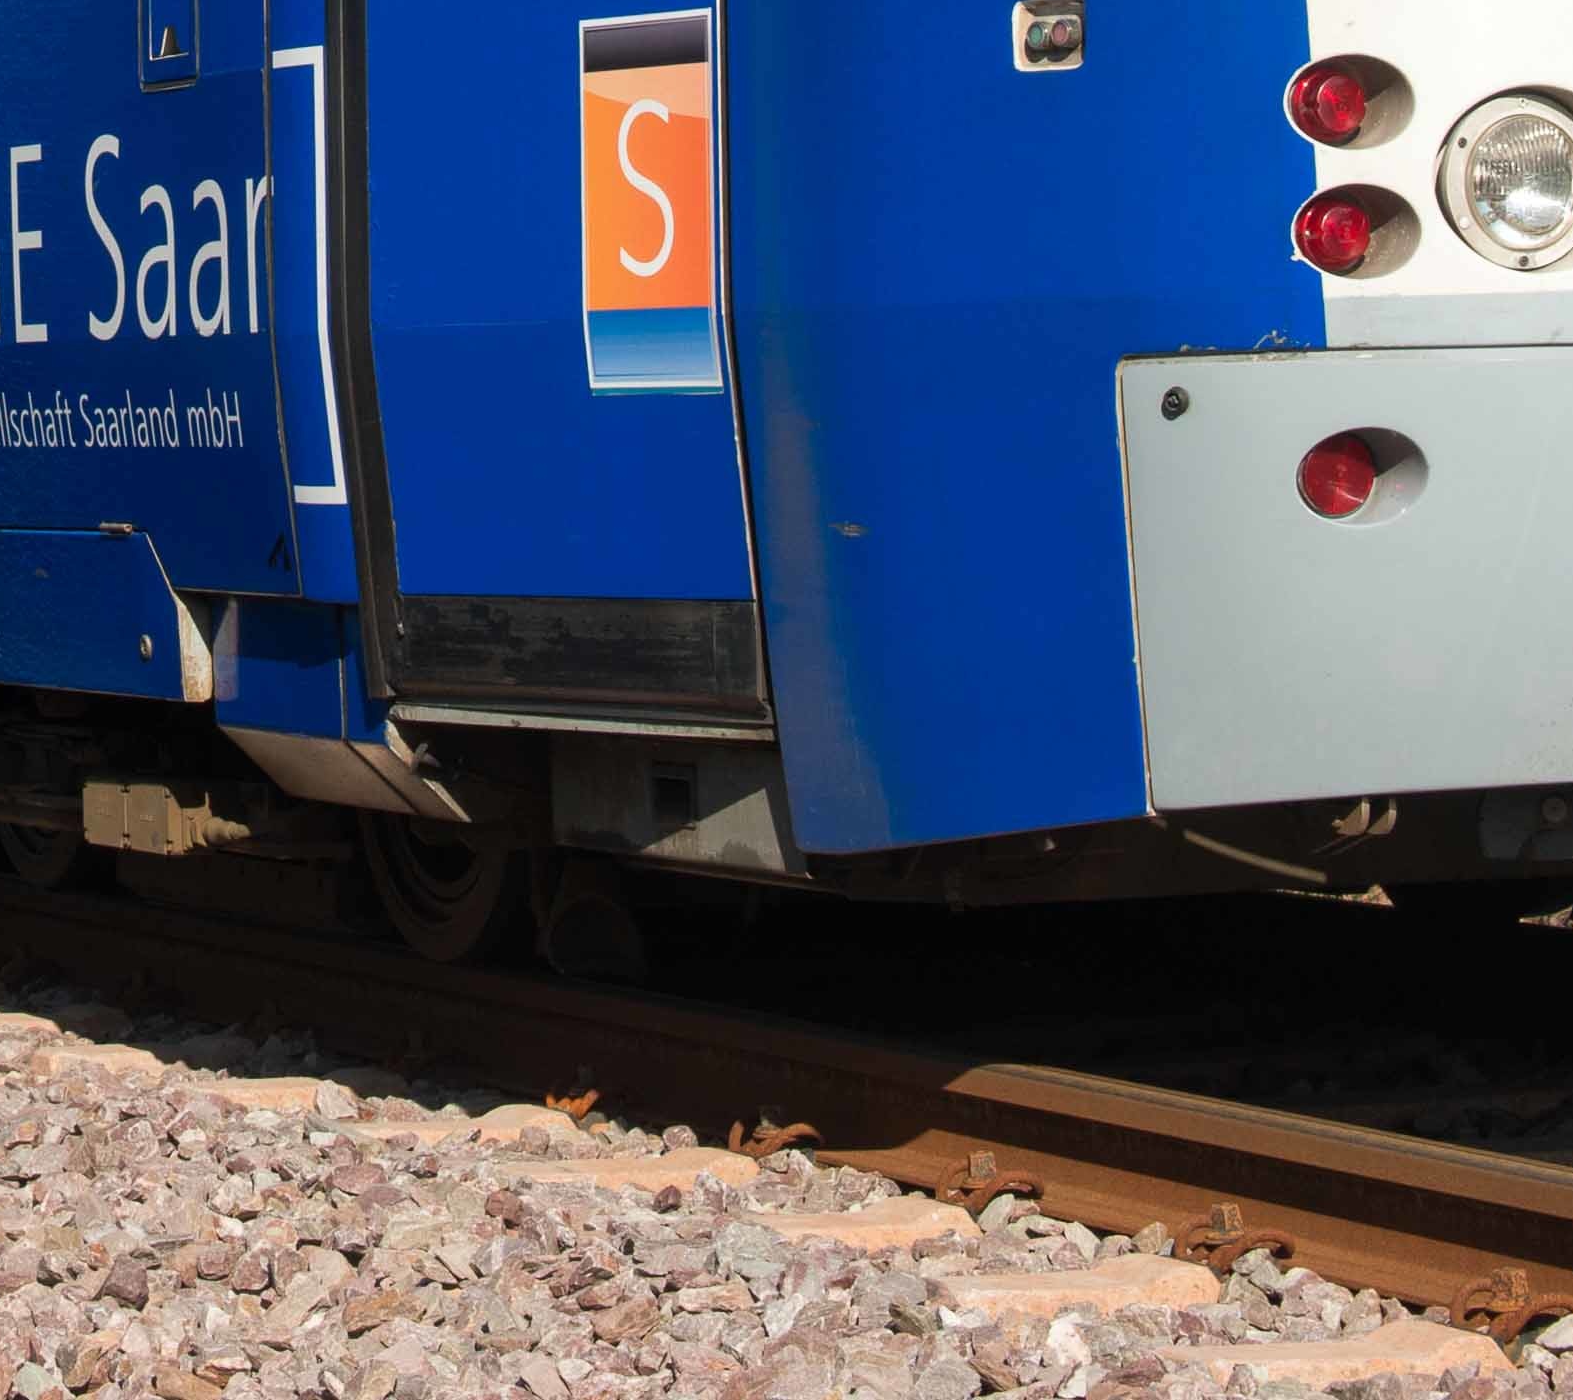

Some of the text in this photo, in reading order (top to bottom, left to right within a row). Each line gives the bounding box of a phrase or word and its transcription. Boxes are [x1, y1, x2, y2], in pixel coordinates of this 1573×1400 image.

[83, 133, 275, 341] Saar
[617, 98, 675, 278] S
[79, 388, 180, 448] Saarland
[187, 386, 244, 448] mbH
